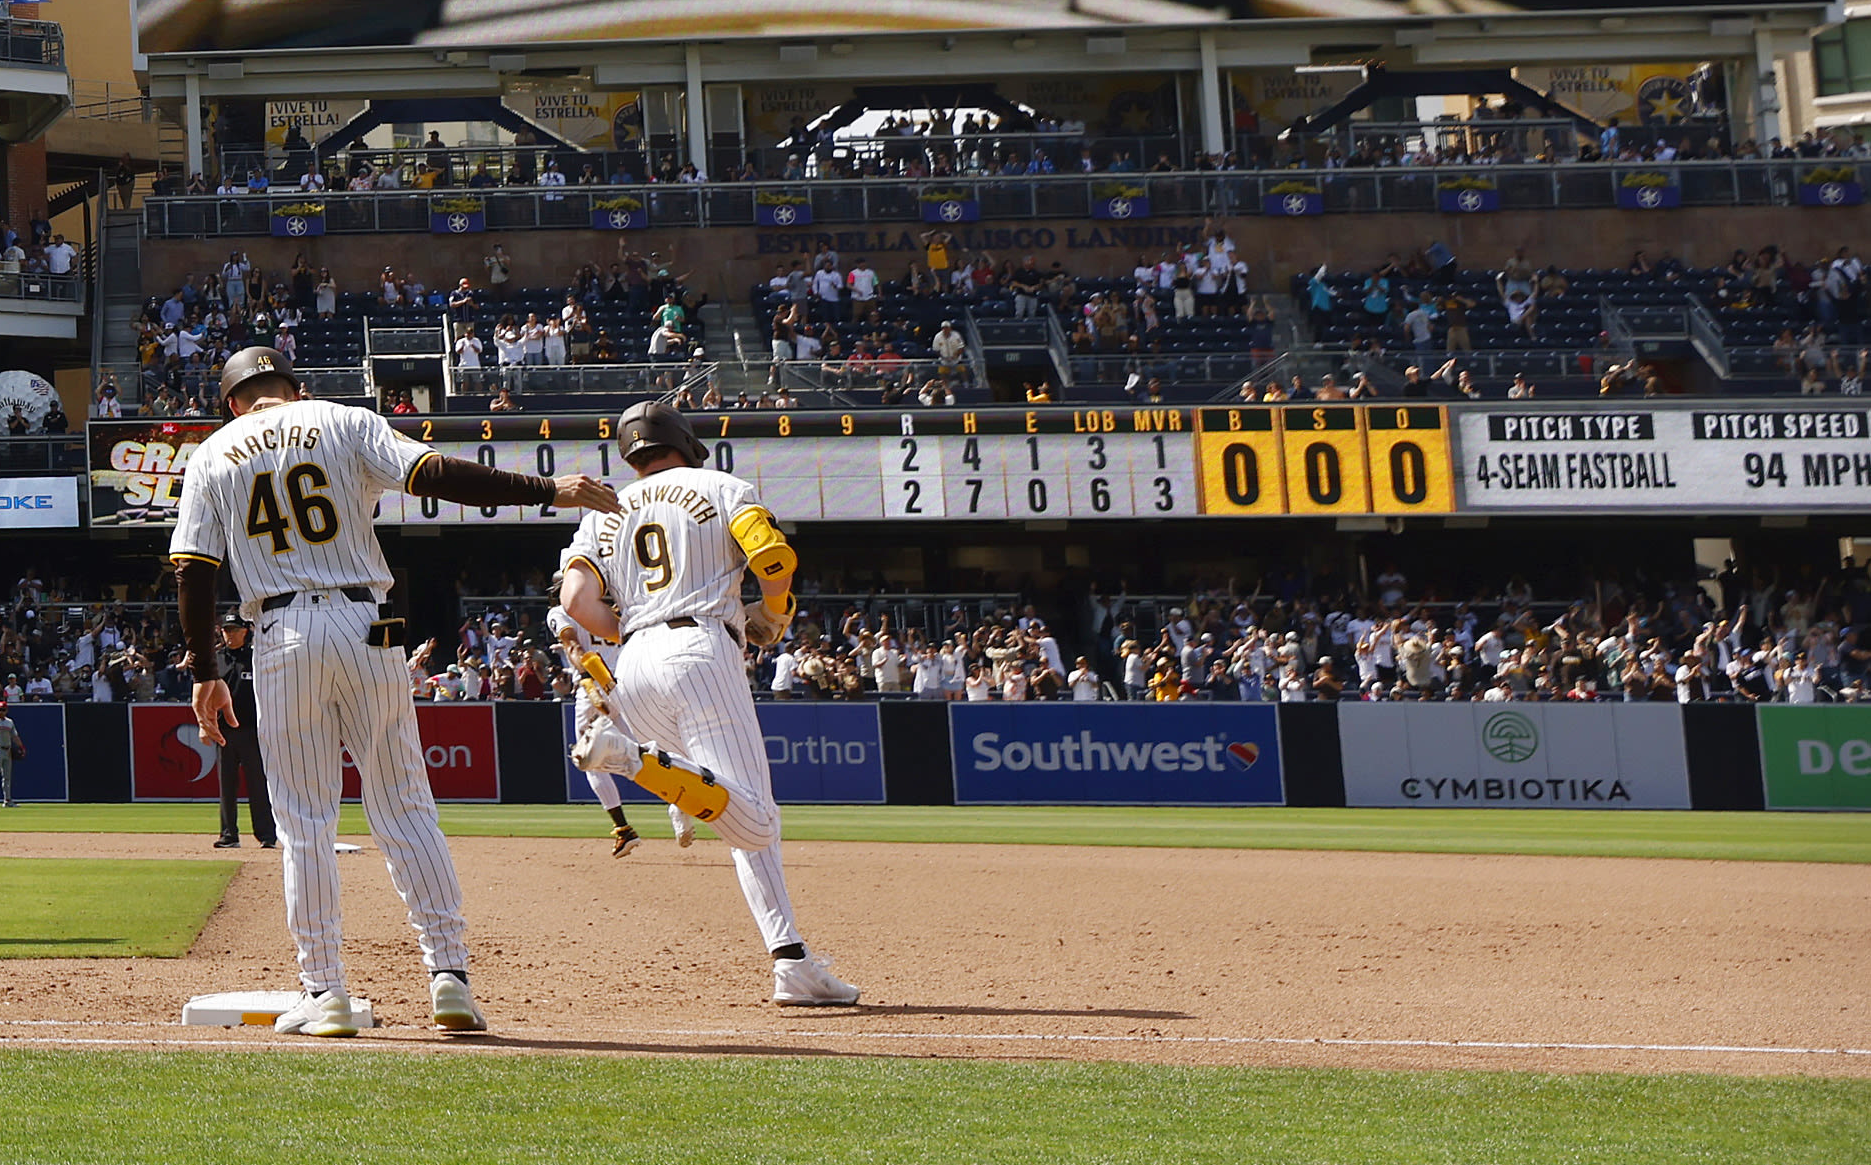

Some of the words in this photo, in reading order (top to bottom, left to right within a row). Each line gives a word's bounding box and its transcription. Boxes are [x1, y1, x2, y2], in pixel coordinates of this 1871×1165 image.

[310, 100, 328, 113] TU
[571, 94, 589, 106] TU
[271, 113, 340, 128] ESTRELLA!
[951, 227, 1057, 250] ALISCO
[257, 355, 271, 365] 46
[421, 419, 434, 441] 2
[481, 419, 493, 441] 3
[539, 417, 551, 440] 4
[598, 417, 610, 439] 5
[718, 415, 730, 437] 7
[779, 414, 792, 436] 8
[841, 413, 854, 436] 9
[900, 413, 914, 435] R
[963, 411, 977, 434] H
[1026, 410, 1038, 433] E
[1074, 409, 1117, 432] LOB
[1133, 409, 1182, 431] MVR
[1229, 409, 1242, 431] B
[1312, 408, 1327, 430] S
[1505, 416, 1573, 441] PITCH
[1581, 415, 1642, 440] TYPE
[1703, 414, 1775, 439] PITCH
[1782, 413, 1860, 438] SPEED
[110, 440, 201, 475] GRA
[224, 425, 321, 467] MACIAS
[536, 443, 555, 477] 0
[597, 442, 610, 477] 1
[715, 440, 734, 475] 0
[900, 438, 920, 472] 2
[962, 437, 982, 472] 4
[1026, 436, 1039, 471] 1
[1087, 436, 1107, 471] 3
[1152, 435, 1166, 470] 1
[1223, 442, 1260, 506] 0
[1304, 441, 1342, 505] 0
[1389, 441, 1427, 505] 0
[1477, 453, 1560, 489] 4-SEAM
[1565, 452, 1677, 489] FASTBALL
[1743, 452, 1788, 488] 94
[1803, 453, 1871, 488] MPH
[123, 473, 181, 508] SL
[903, 479, 922, 514] 2
[965, 479, 983, 513] 7
[1028, 479, 1048, 513] 0
[1090, 477, 1111, 512] 6
[1153, 477, 1174, 511] 3
[247, 462, 341, 555] 46
[598, 484, 718, 559] CRONENWORTH
[634, 522, 674, 594] 9
[973, 730, 1226, 772] Southwest
[1798, 739, 1871, 776] De
[1400, 777, 1631, 802] CYMBIOTIKA
